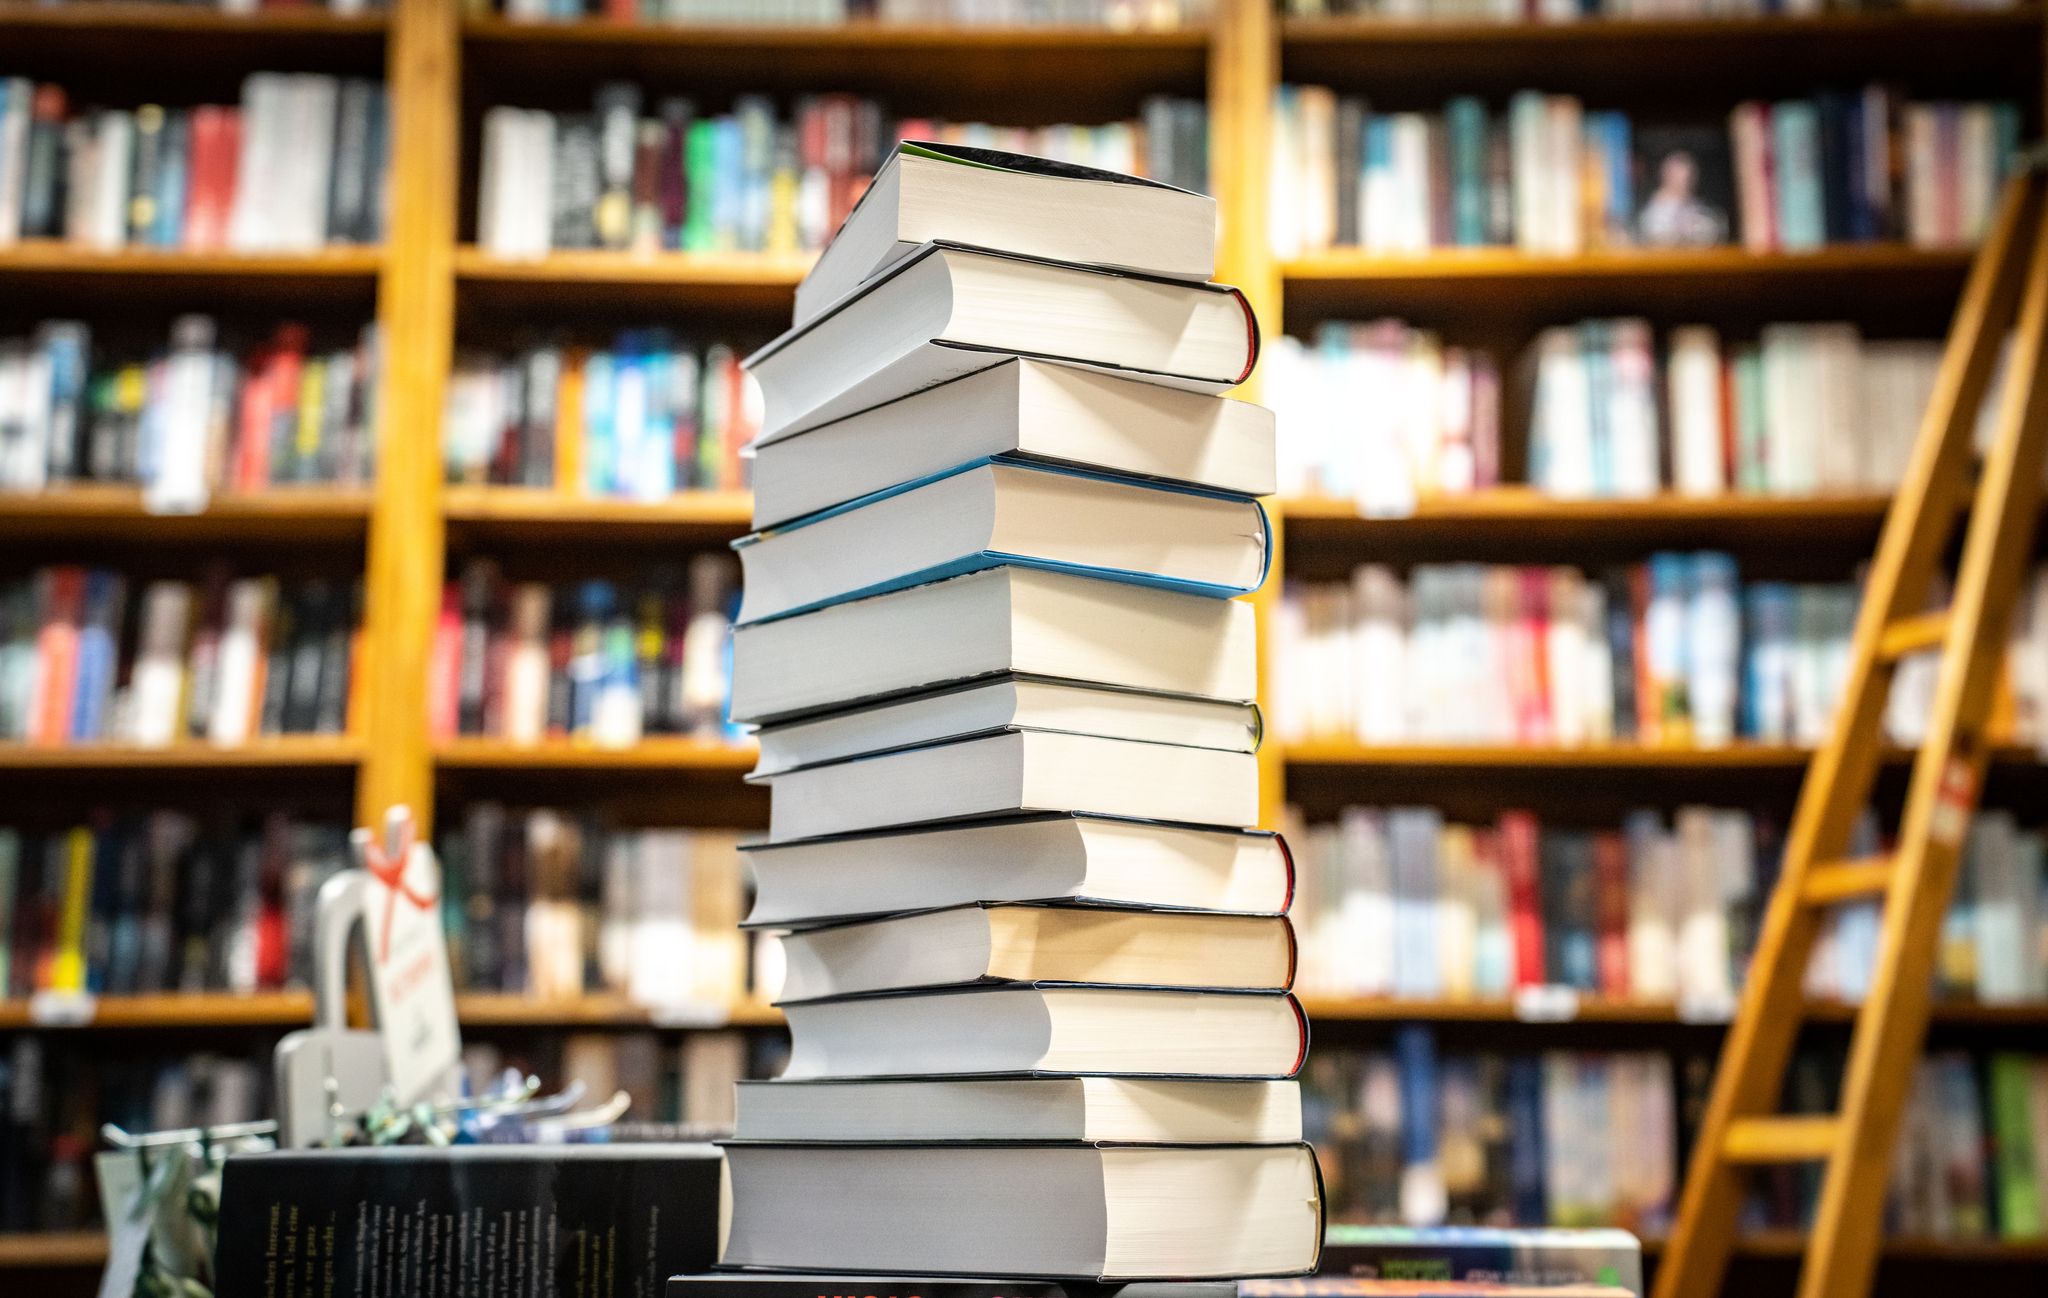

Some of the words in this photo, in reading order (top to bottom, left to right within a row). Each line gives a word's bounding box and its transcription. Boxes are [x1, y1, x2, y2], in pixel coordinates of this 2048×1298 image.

[265, 1201, 280, 1257] Internat.
[288, 1206, 298, 1232] eine
[283, 1236, 296, 1264] Und
[306, 1225, 318, 1256] ganz
[322, 1226, 334, 1257] steht
